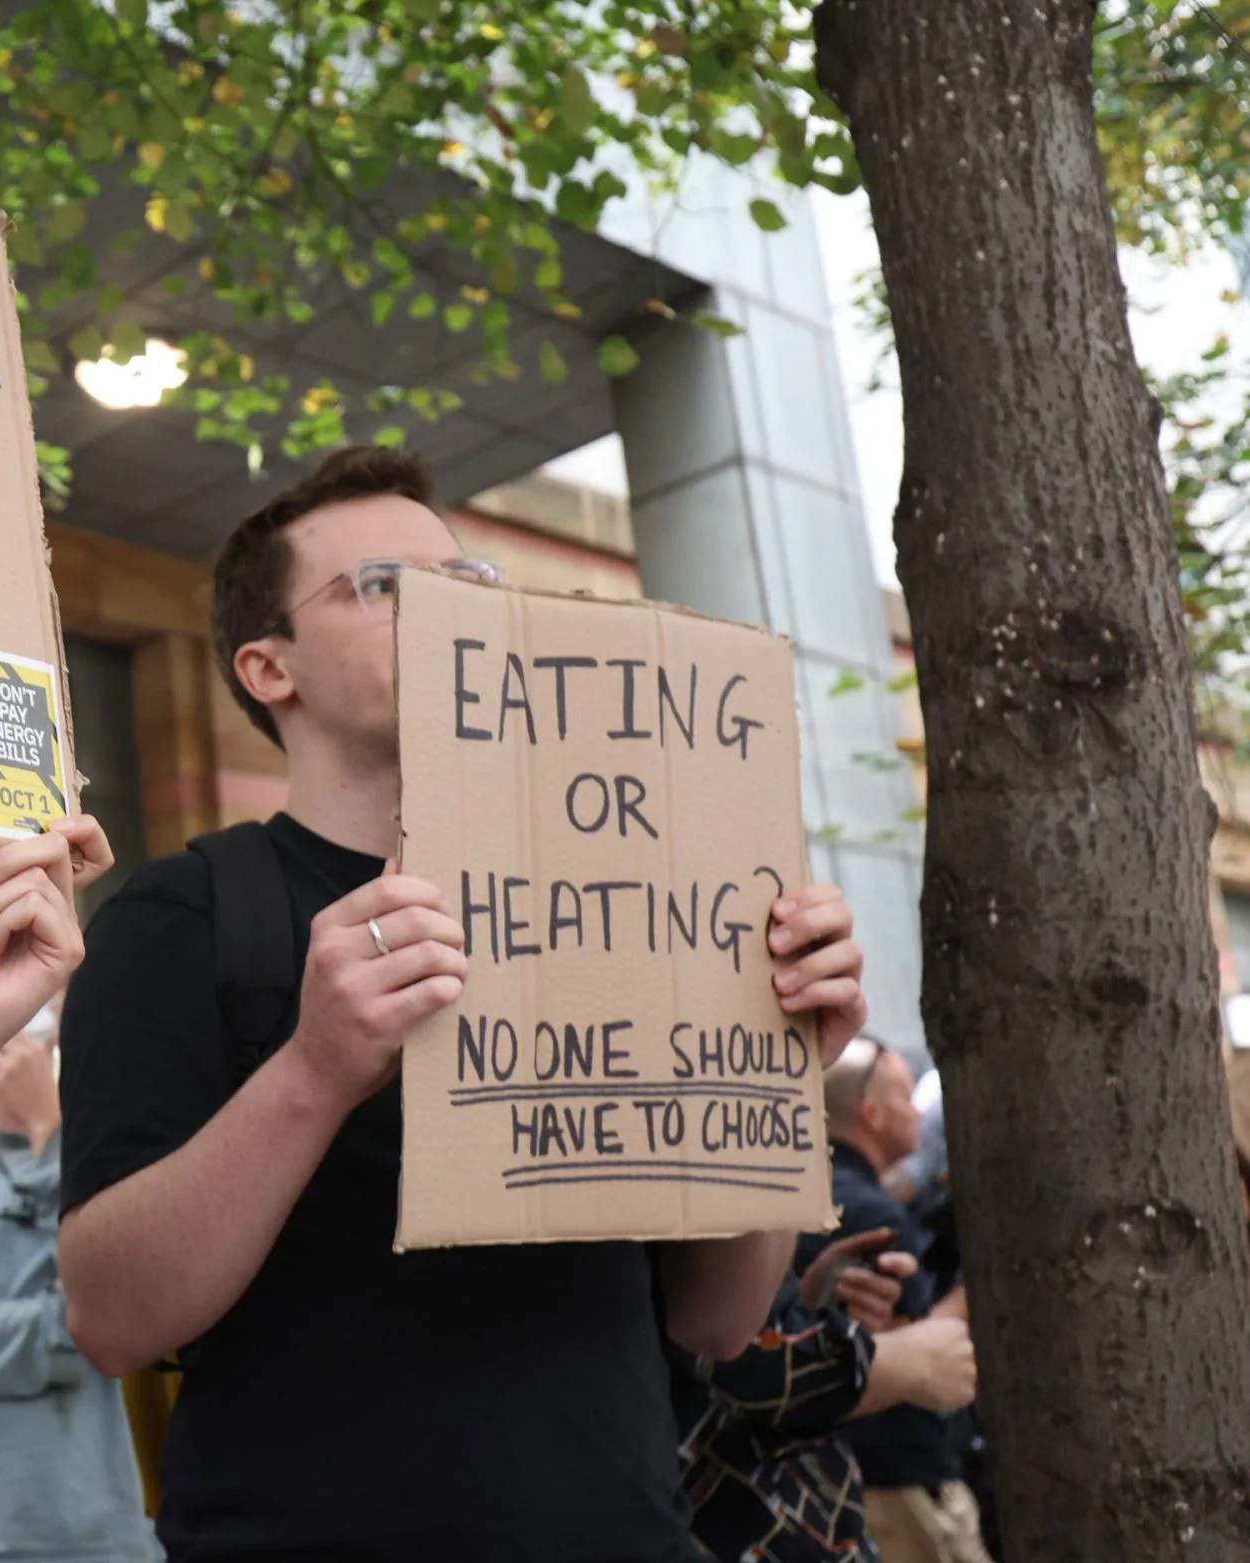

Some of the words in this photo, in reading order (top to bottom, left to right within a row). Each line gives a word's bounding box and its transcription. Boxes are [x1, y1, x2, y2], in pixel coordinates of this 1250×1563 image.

[453, 638, 765, 760] EATING
[0, 786, 35, 811] OCT
[40, 795, 52, 815] 1
[565, 773, 658, 839] OR
[456, 1015, 519, 1081] NO
[534, 1021, 640, 1080] ONE
[671, 1023, 809, 1080] SHOULD
[511, 1105, 625, 1157] HAVE
[633, 1101, 686, 1153] TO
[701, 1099, 814, 1153] CHOOSE
